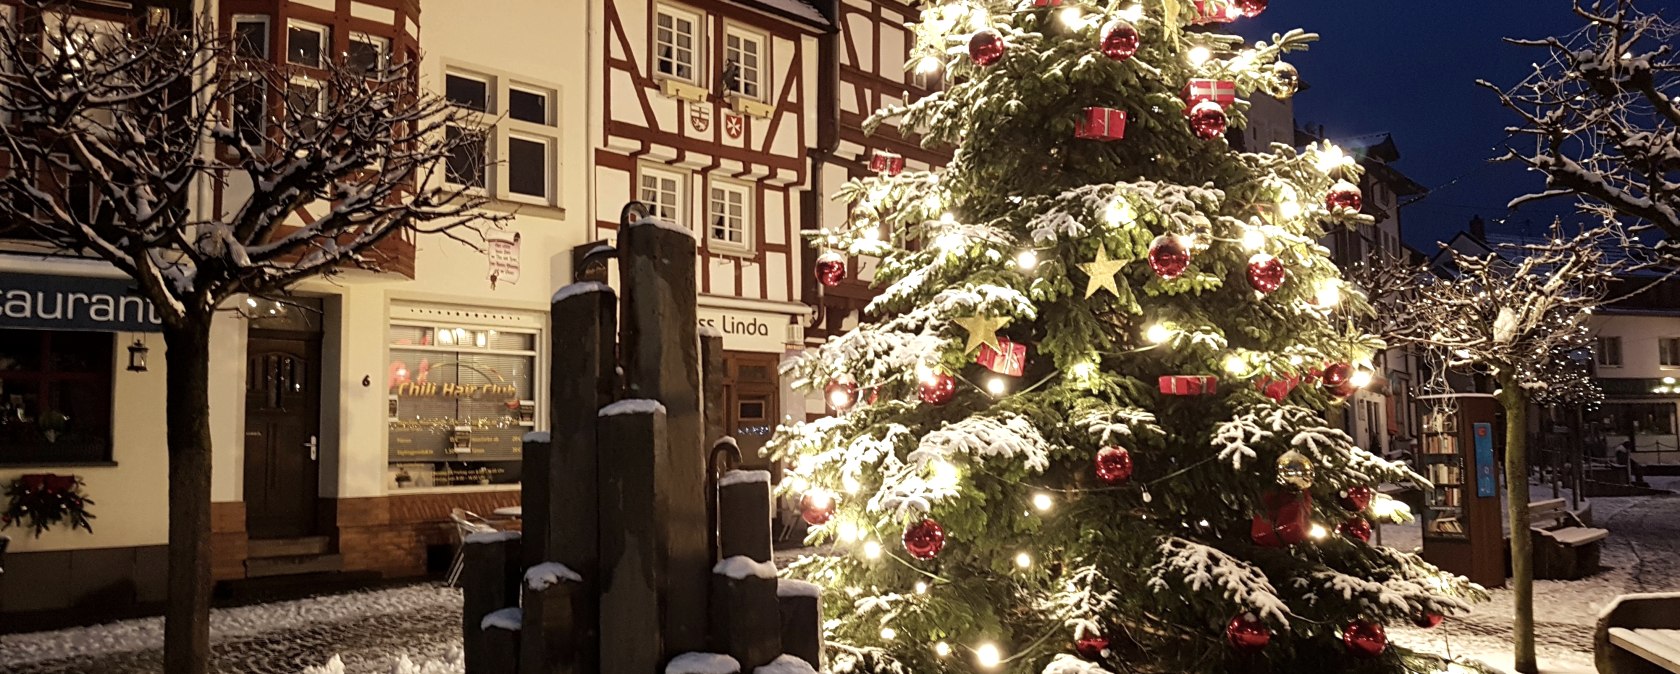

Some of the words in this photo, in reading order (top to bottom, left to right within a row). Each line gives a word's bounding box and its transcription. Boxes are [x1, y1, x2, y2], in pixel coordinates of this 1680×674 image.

[0, 289, 162, 324] aurant
[722, 315, 769, 336] Linda
[362, 374, 371, 387] 6
[398, 382, 437, 397] Chili
[442, 383, 477, 397] Hair
[482, 384, 517, 395] Club
